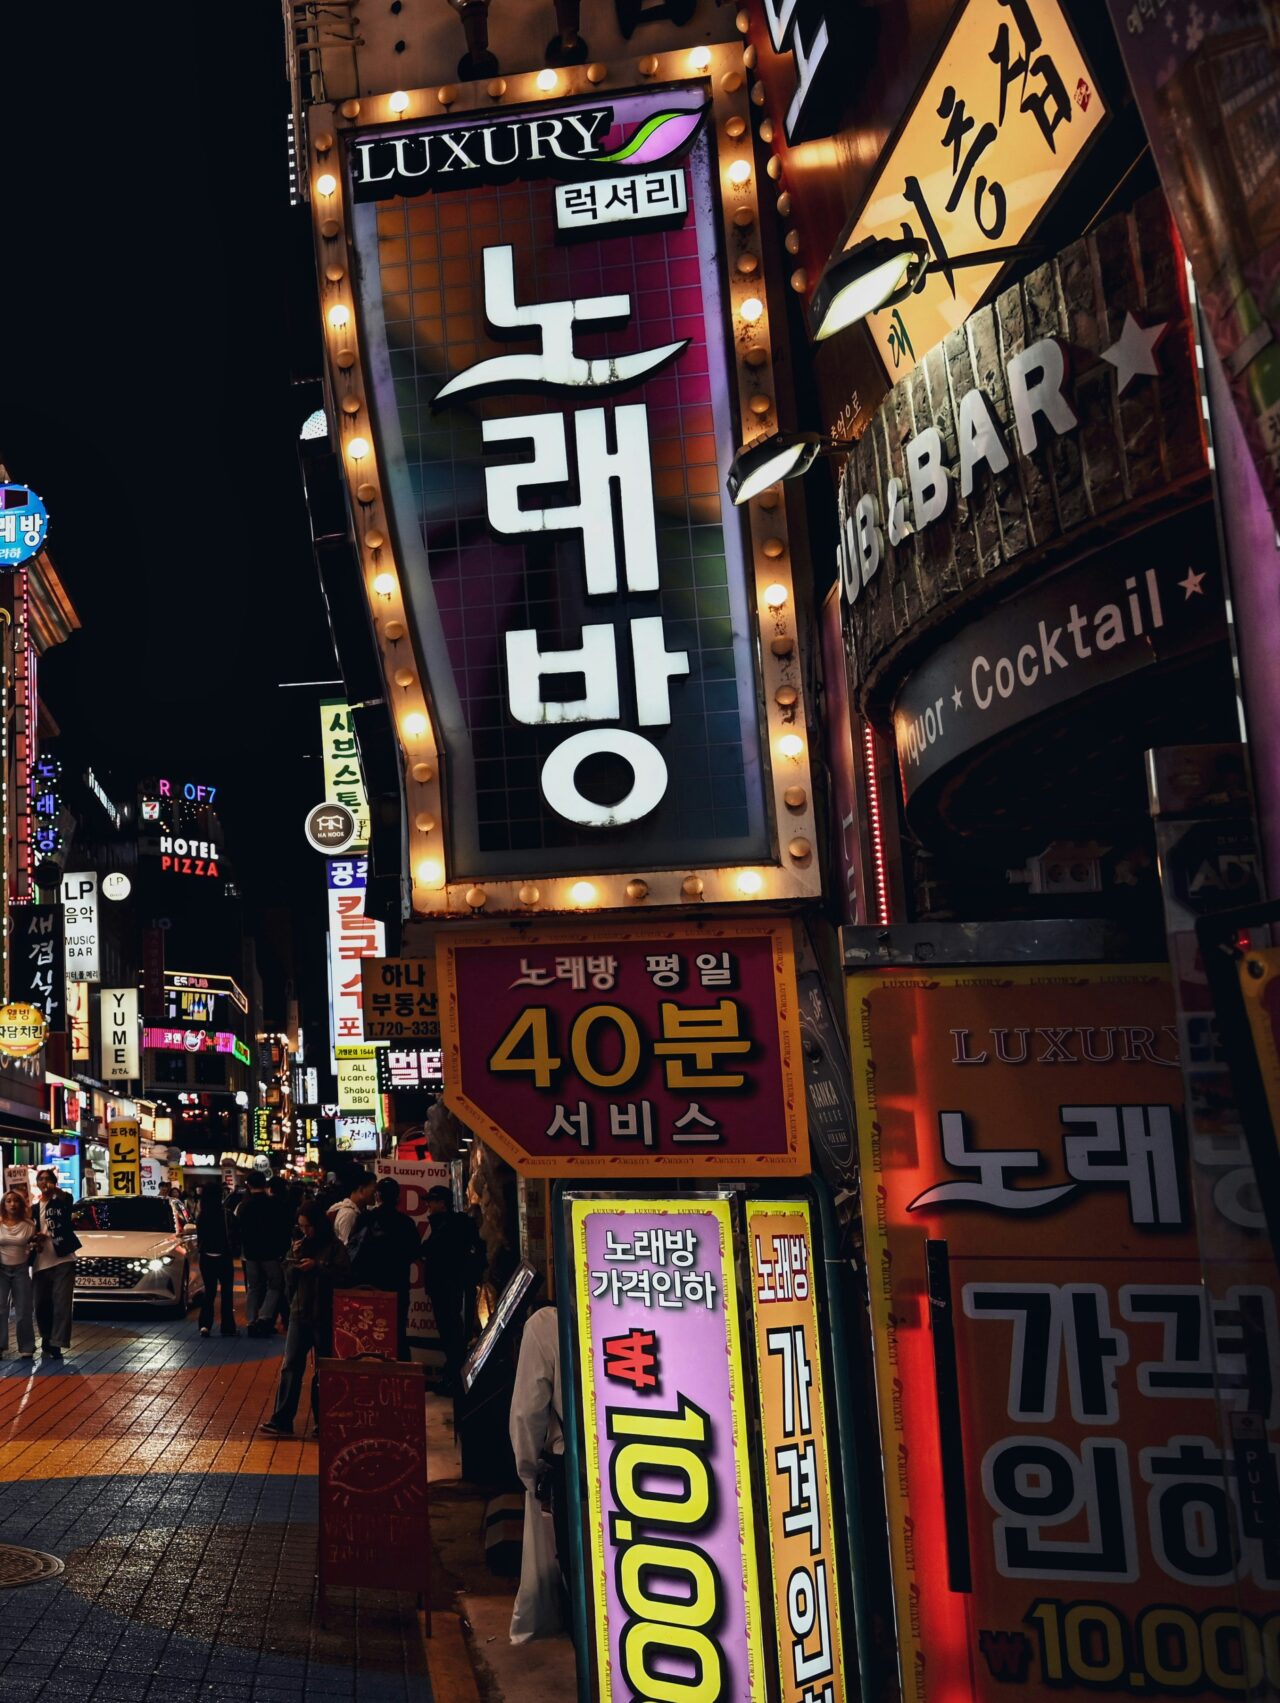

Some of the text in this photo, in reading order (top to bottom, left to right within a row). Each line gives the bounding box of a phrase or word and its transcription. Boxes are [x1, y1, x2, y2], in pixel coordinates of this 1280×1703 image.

[356, 110, 609, 184] LUXURY
[563, 173, 681, 220] 럭셔리
[431, 243, 693, 829] 노래방
[969, 568, 1165, 712] Cocktail
[33, 757, 60, 849] 노래방
[159, 835, 220, 861] HOTEL
[161, 855, 219, 878] PIZZA
[64, 880, 95, 900] LP
[64, 906, 94, 924] 음악
[64, 934, 96, 946] MUSIC
[68, 947, 94, 958] BAR
[381, 963, 426, 988] 하나
[508, 951, 733, 991] 노래방 평일
[1030, 976, 1077, 987] LUXURY
[1100, 975, 1149, 986] LUXURY
[882, 978, 929, 990] LUXURY
[955, 978, 1002, 989] LUXURY
[371, 992, 438, 1017] 부동산
[111, 992, 127, 1064] YUME
[368, 1021, 440, 1037] T.720-333
[489, 999, 752, 1090] 40분
[111, 1067, 130, 1075] おでん
[352, 1064, 367, 1072] ALL
[343, 1086, 371, 1095] Shabu
[352, 1095, 370, 1104] BBQ
[110, 1126, 137, 1138] 프라하
[546, 1099, 720, 1147] 서비스
[111, 1142, 137, 1195] 노래
[393, 1167, 448, 1178] Luxury DVD
[604, 1228, 698, 1267] 노래방
[98, 1275, 118, 1286] 3463
[755, 1234, 810, 1305] 노래방
[591, 1269, 717, 1310] 가격인하
[1244, 1450, 1265, 1524] PULL
